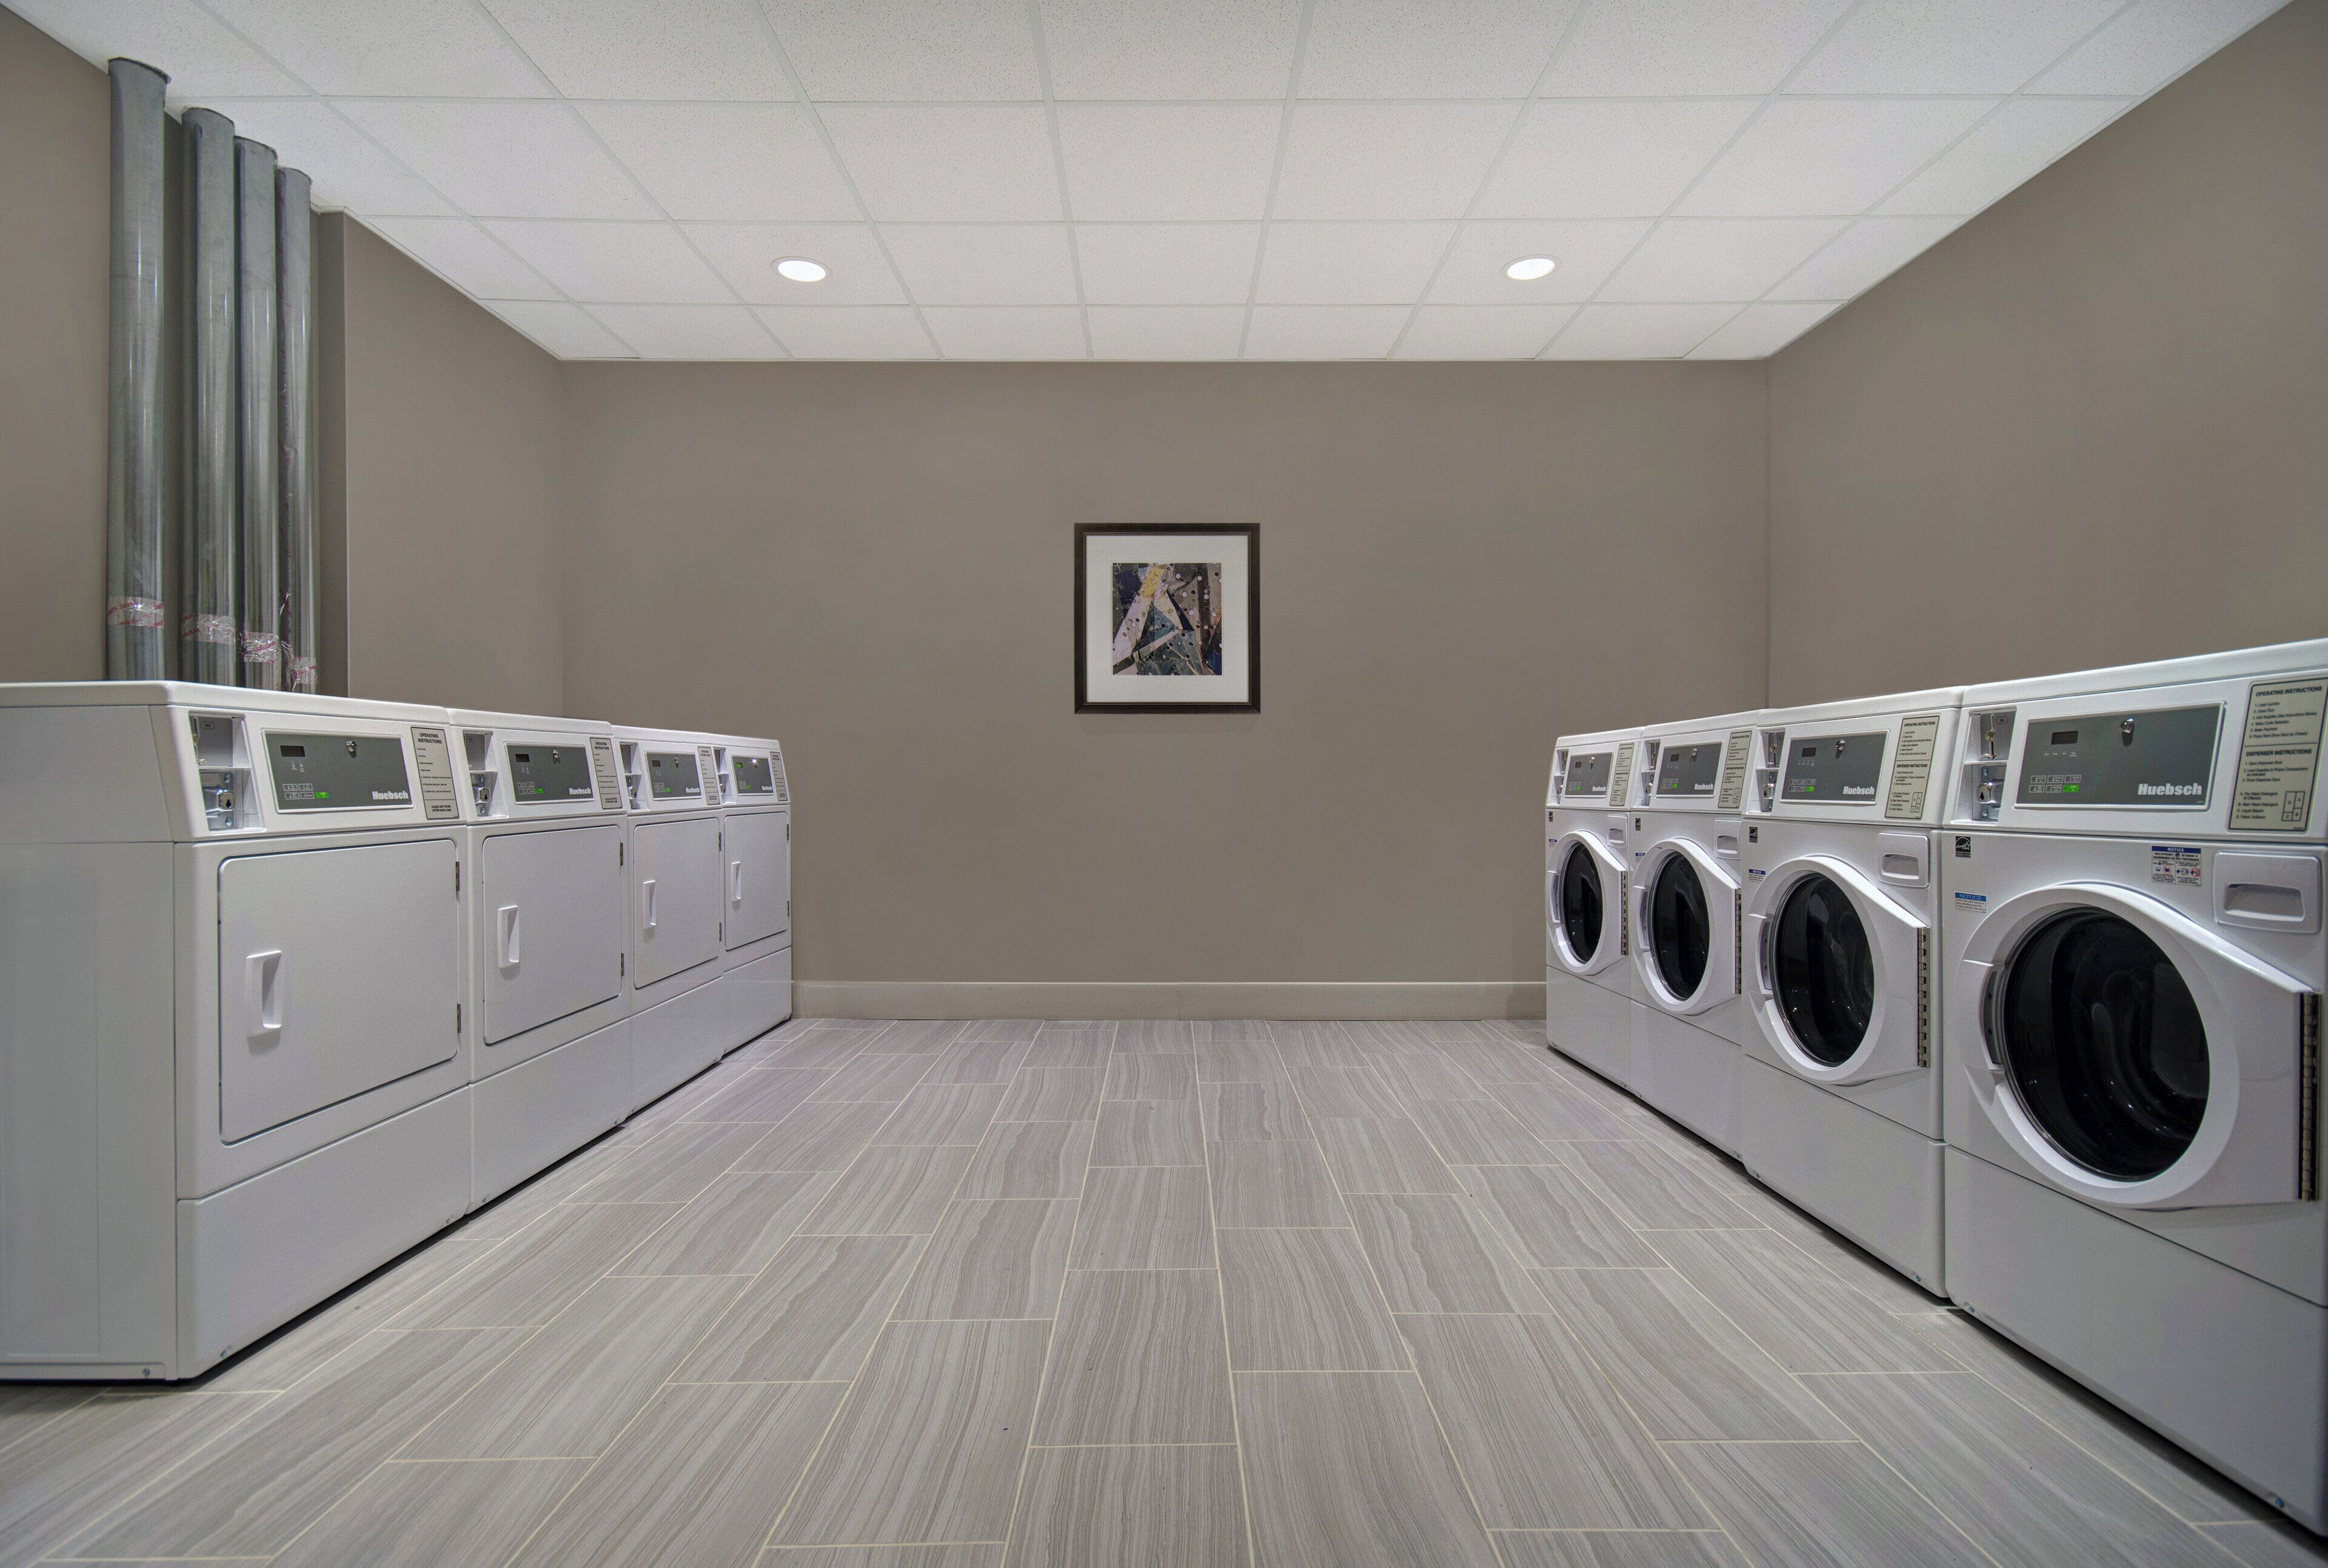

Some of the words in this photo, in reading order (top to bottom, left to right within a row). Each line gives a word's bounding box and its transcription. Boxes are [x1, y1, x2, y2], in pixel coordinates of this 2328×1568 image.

[2285, 686, 2322, 694] INSTRUCTIONS
[1843, 786, 1875, 795] Huebsch
[2138, 782, 2202, 795] Huebsch
[372, 790, 409, 799] Huebsch
